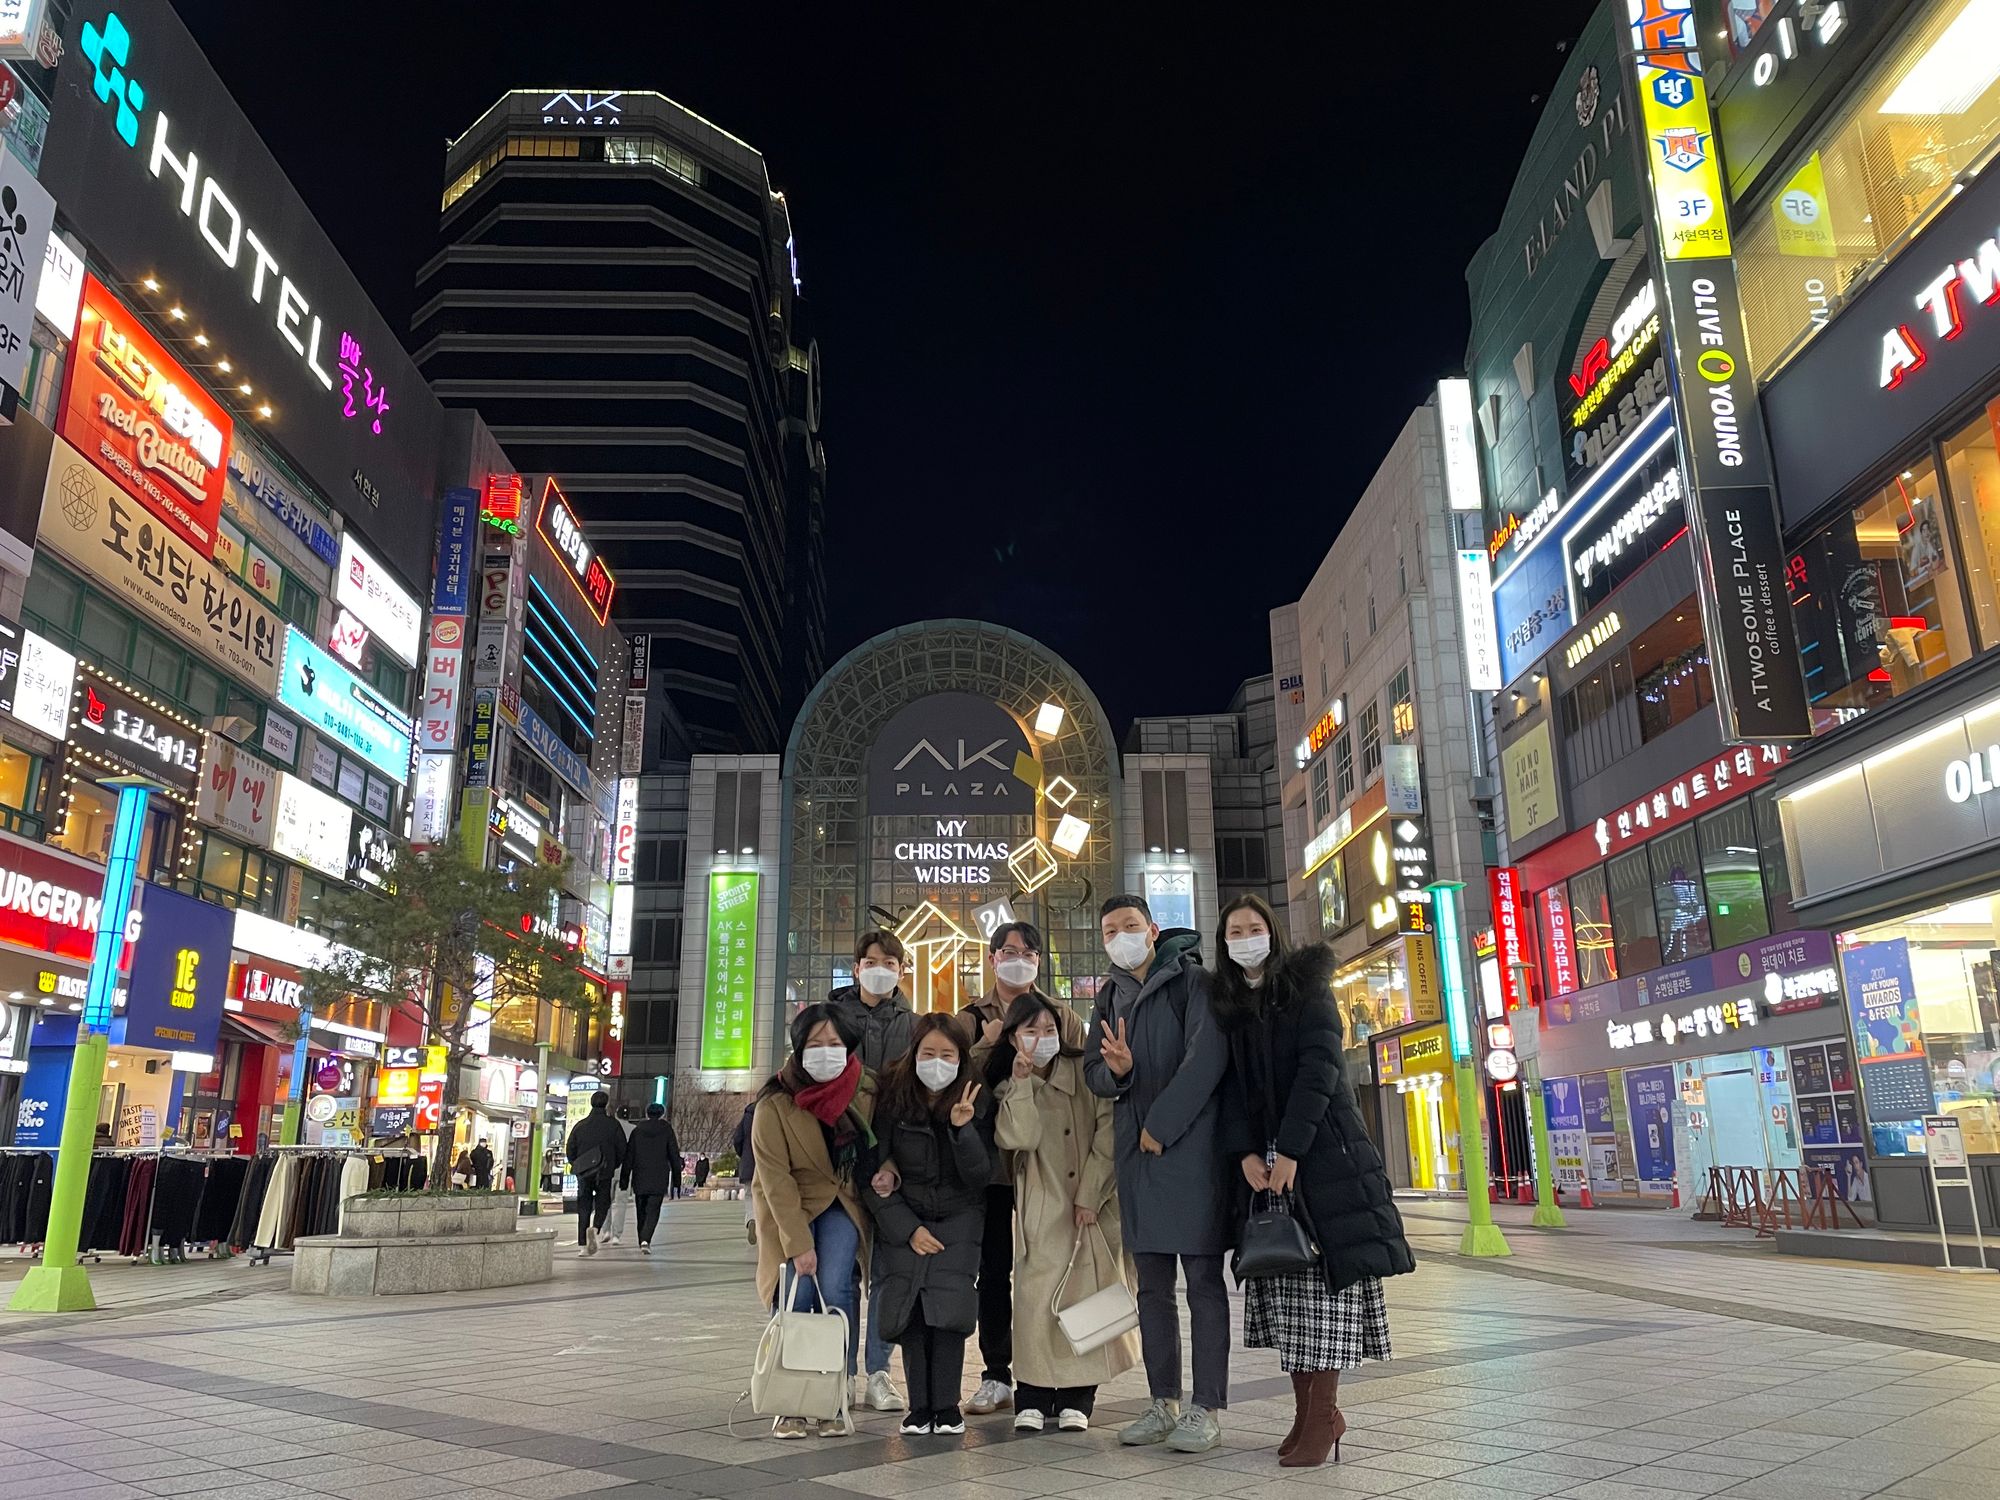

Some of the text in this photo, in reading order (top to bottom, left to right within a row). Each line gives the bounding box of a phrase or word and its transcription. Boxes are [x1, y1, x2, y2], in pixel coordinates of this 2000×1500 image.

[541, 91, 622, 112] AK
[543, 116, 620, 125] PLAZA
[1601, 92, 1630, 159] PL
[1678, 199, 1707, 217] 3F
[1672, 228, 1725, 242] 서현역점
[148, 110, 333, 392] HOTEL
[1691, 278, 1724, 347] OLIVE
[1631, 314, 1661, 357] CAFE
[1568, 337, 1610, 398] VR
[1880, 327, 1920, 389] A
[1708, 383, 1744, 467] YOUNG
[99, 392, 208, 488] Red Button
[353, 468, 381, 509] 서현점
[479, 509, 520, 536] Cafe
[101, 496, 196, 605] 도원당
[200, 572, 276, 668] 한의원
[1755, 563, 1774, 607] dessert
[122, 574, 203, 638] www.dowondang.com
[1724, 508, 1773, 713] A TWOSOME PLACE
[1565, 610, 1622, 669] JUNO HAIR
[1764, 616, 1780, 656] coffee
[425, 656, 457, 744] 버거킹
[471, 702, 492, 762] 원룸텔
[472, 761, 487, 771] 4F
[893, 738, 1010, 771] AK
[1515, 749, 1540, 776] JUNO
[896, 783, 1009, 796] PLAZA
[1519, 773, 1540, 793] HAIR
[936, 820, 967, 837] MY
[1526, 802, 1539, 828] 3F
[617, 824, 633, 864] PC
[895, 842, 1009, 861] CHRISTMAS
[1393, 847, 1428, 862] HAIR
[914, 866, 991, 884] WISHES
[1151, 873, 1186, 885] AK
[716, 881, 752, 902] SPORTS
[716, 893, 750, 913] STREET
[918, 887, 930, 895] THE
[967, 887, 1009, 896] CALENDAR
[83, 896, 143, 943] KG
[979, 904, 1013, 937] 24
[1408, 904, 1425, 932] 치과
[1415, 939, 1429, 995] MINS COFFEE
[1761, 946, 1807, 973] 원데이 치료
[730, 920, 748, 1040] 스포츠스트리트
[1655, 976, 1693, 999] 수면임플란트
[1861, 977, 1899, 992] OLIVE YOUNG
[1871, 967, 1887, 981] 2021
[170, 989, 196, 1010] EURO
[269, 976, 305, 1009] KFC
[1865, 988, 1901, 1007] AWARDS
[714, 1000, 727, 1040] 만나는
[1868, 1004, 1902, 1021] &FESTA
[386, 1048, 418, 1065] PC
[1492, 1055, 1516, 1075] 약
[122, 1104, 143, 1117] TASTE
[415, 1094, 440, 1121] PC
[1772, 1104, 1788, 1134] 약
[119, 1117, 133, 1129] ONE
[513, 1122, 529, 1138] 약
[1690, 1111, 1704, 1136] 약
